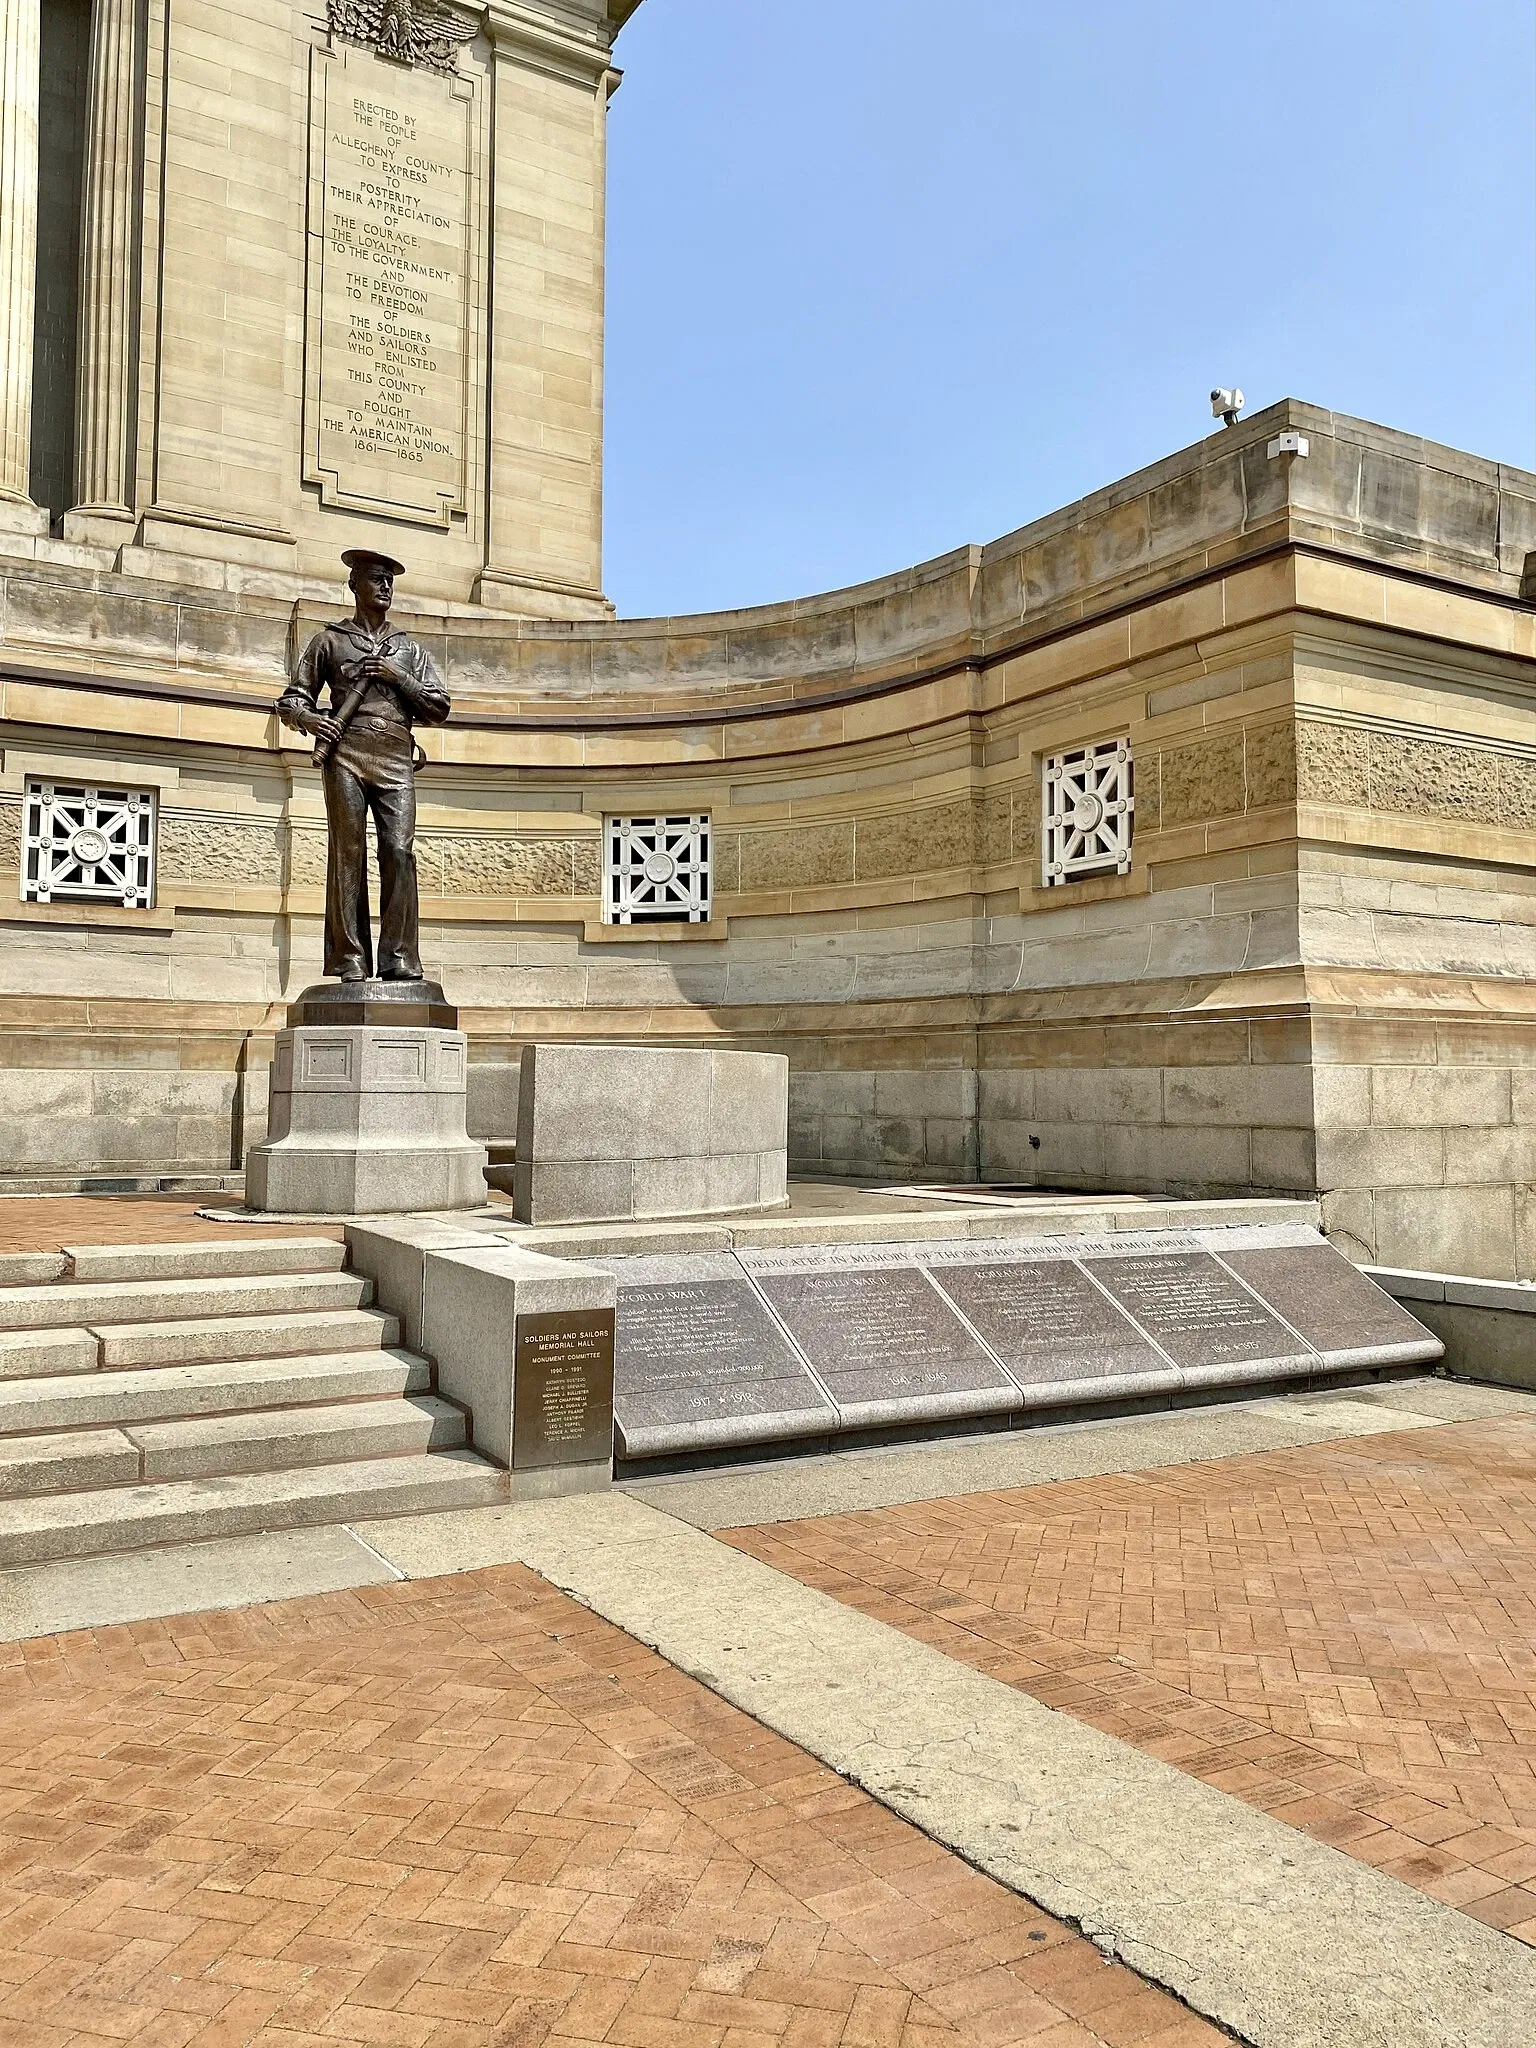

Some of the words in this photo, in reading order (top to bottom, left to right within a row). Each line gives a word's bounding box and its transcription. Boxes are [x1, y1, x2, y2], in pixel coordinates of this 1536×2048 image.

[353, 99, 398, 120] ERECTED
[405, 115, 416, 127] BY
[353, 112, 373, 126] THE
[379, 121, 416, 140] PEOPLE
[387, 137, 401, 148] OF
[332, 133, 395, 159] ALLEGHENY
[406, 156, 452, 177] COUNTY
[360, 155, 375, 167] TO
[382, 162, 427, 184] EXPRESS
[386, 176, 400, 188] TO
[360, 182, 420, 208] POSTERITY
[331, 186, 363, 204] THEIR
[367, 198, 450, 228] APPRECIATION
[333, 215, 356, 229] THE
[384, 216, 398, 227] OF
[332, 228, 352, 242] THE
[331, 242, 345, 253] TO
[349, 246, 368, 260] THE
[381, 270, 404, 282] AND
[346, 273, 368, 287] THE
[374, 281, 427, 302] DEVOTION
[346, 287, 361, 299] TO
[371, 294, 423, 316] FREEDOM
[384, 311, 397, 321] OF
[350, 315, 370, 328] THE
[377, 323, 431, 343] SOLDIERS
[348, 329, 372, 343] AND
[380, 337, 427, 355] SAILORS
[348, 342, 373, 356] WHO
[386, 352, 436, 371] ENLISTED
[374, 362, 404, 377] FROM
[348, 369, 372, 383] THIS
[379, 377, 426, 396] COUNTY
[378, 391, 402, 403] AND
[364, 401, 411, 419] FOUGHT
[347, 410, 362, 422] TO
[376, 418, 431, 437] MAINTAIN
[324, 419, 343, 431] THE
[350, 425, 409, 447] AMERICAN
[745, 1255, 826, 1269] DEDICATED
[830, 1256, 846, 1264] IN
[851, 1253, 909, 1263] MEMORY
[915, 1251, 933, 1260] OF
[934, 1250, 980, 1260] THOSE
[982, 1248, 1015, 1257] WHO
[1018, 1246, 1062, 1254] SERVED
[1065, 1244, 1080, 1253] IN
[1084, 1244, 1105, 1252] THE
[1110, 1241, 1150, 1251] ARMED
[1152, 1238, 1201, 1248] SERVICES
[616, 1293, 665, 1302] WORLD
[668, 1291, 698, 1299] WAR
[525, 1334, 559, 1343] SOLDIERS
[580, 1330, 608, 1338] SAILORS
[539, 1342, 575, 1350] MEMORIAL
[568, 1352, 600, 1360] COMMITTEE
[690, 1397, 711, 1407] 1917
